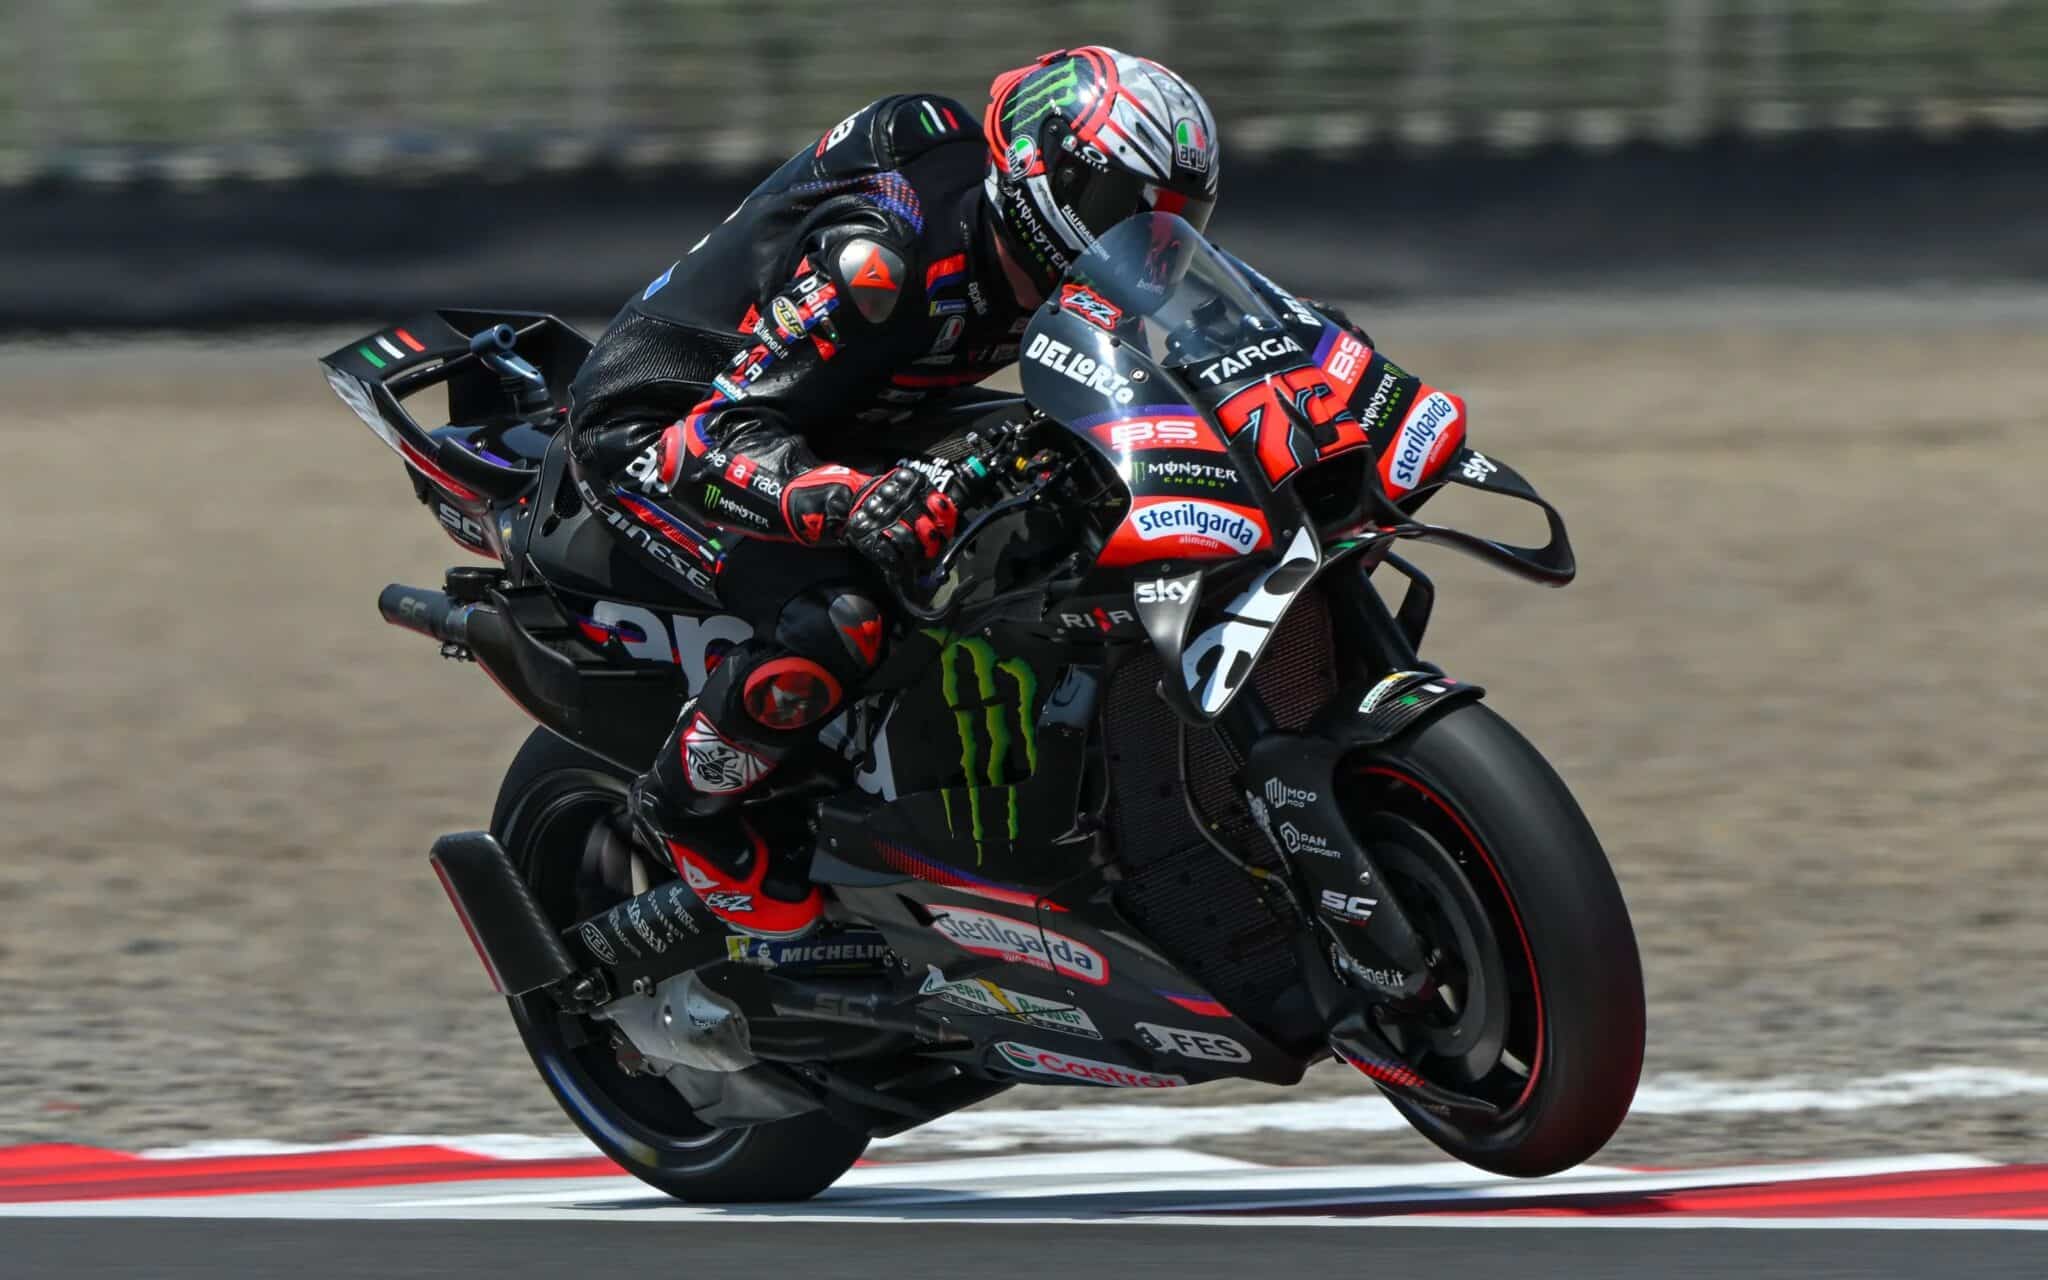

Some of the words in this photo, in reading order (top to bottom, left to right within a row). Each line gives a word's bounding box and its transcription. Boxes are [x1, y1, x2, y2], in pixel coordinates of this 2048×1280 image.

[1025, 333, 1134, 404] DELLORTO
[1199, 335, 1304, 386] TARGA
[1327, 337, 1363, 381] BS
[1111, 420, 1198, 443] BS
[1397, 397, 1453, 483] sterilgarda
[1148, 461, 1238, 483] MONSTER
[1462, 450, 1498, 483] sky
[719, 496, 769, 528] MONSTER
[1138, 504, 1254, 546] sterilgarda
[1137, 578, 1197, 604] sky
[1287, 788, 1317, 802] MOD
[1300, 833, 1327, 847] PAN
[1321, 889, 1378, 917] SC
[1169, 1032, 1242, 1058] FES
